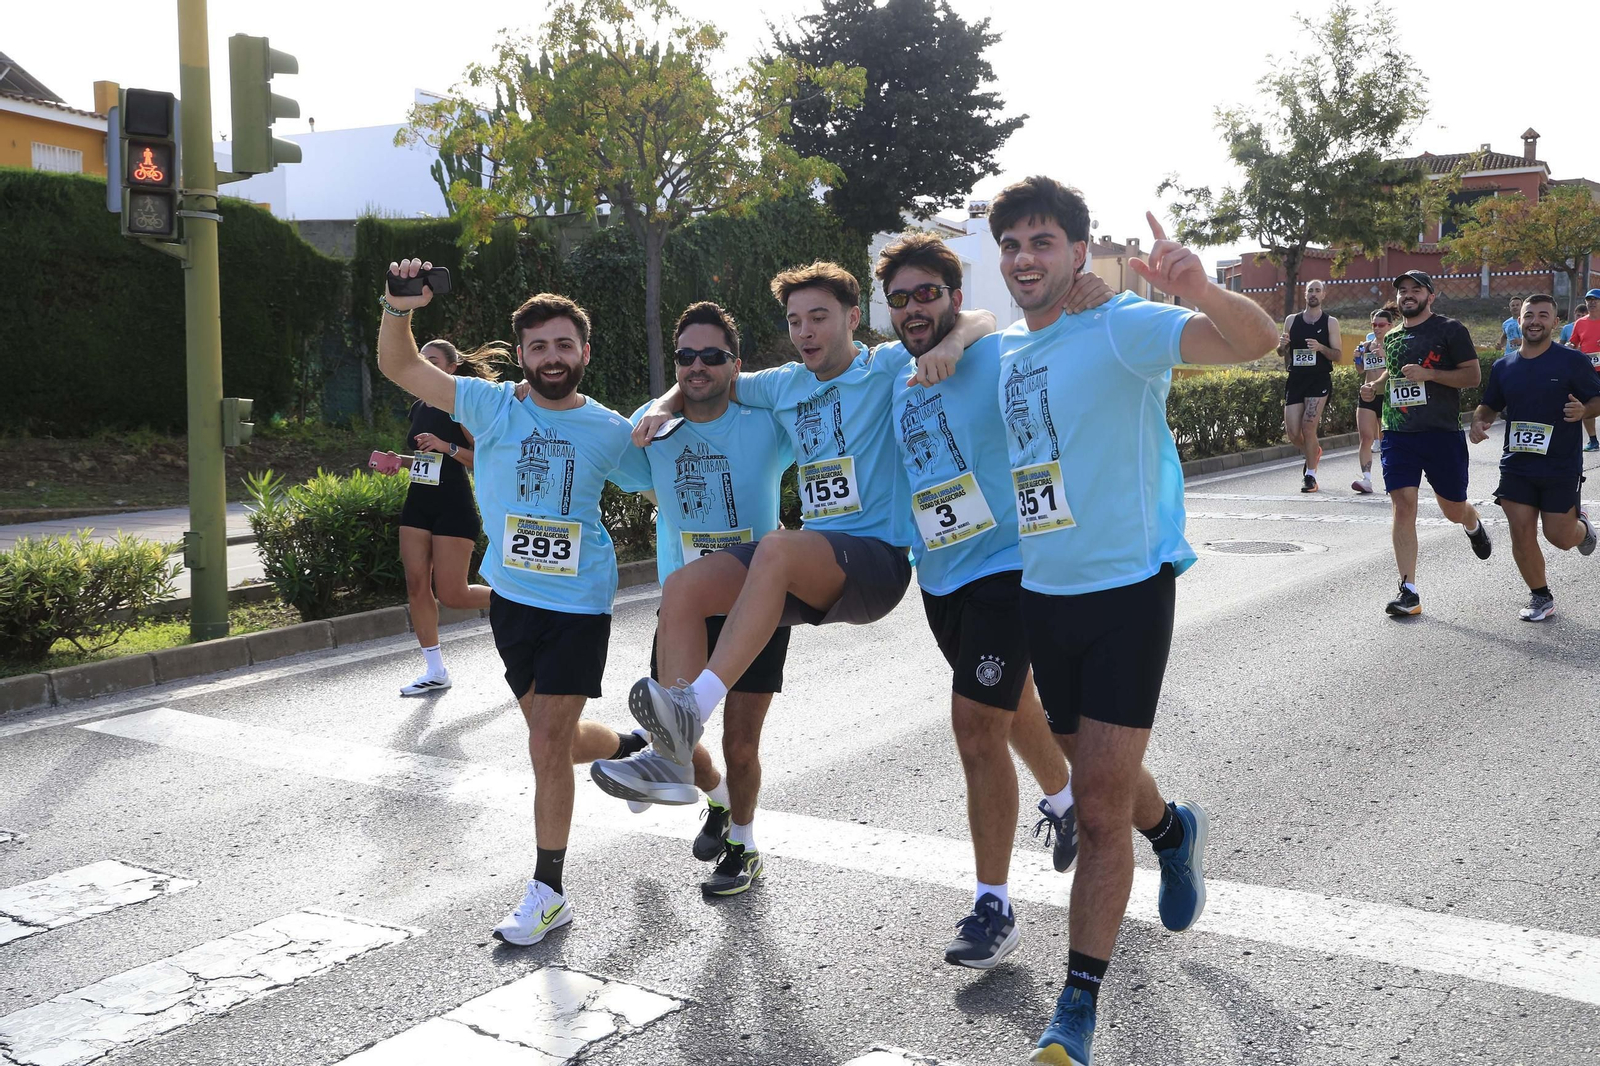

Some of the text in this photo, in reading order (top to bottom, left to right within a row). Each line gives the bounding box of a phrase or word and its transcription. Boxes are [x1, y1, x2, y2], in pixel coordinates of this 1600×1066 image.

[1022, 355, 1033, 372] XXV
[1026, 366, 1048, 378] CARRERA
[1024, 372, 1047, 394] URBANA
[1394, 386, 1420, 398] 106
[920, 399, 943, 421] URBANA
[544, 428, 557, 439] XXV
[1514, 432, 1545, 445] 132
[696, 442, 709, 455] XXV
[939, 414, 964, 469] ALGECIRAS
[547, 444, 575, 458] URBANA
[414, 462, 429, 474] 41
[701, 460, 730, 473] URBANA
[821, 464, 842, 473] URBANA
[821, 470, 843, 479] ALGECIRAS
[1029, 470, 1051, 481] URBANA
[562, 461, 573, 514] ALGECIRAS
[1030, 478, 1052, 488] ALGECIRAS
[804, 477, 849, 504] 153
[918, 484, 963, 504] CARRERA URBANA
[723, 474, 736, 526] ALGECIRAS
[920, 502, 934, 510] CIUDAD
[940, 490, 966, 504] ALGECIRAS
[1018, 485, 1057, 516] 351
[935, 504, 957, 528] 3
[518, 523, 544, 531] CARRERA
[512, 534, 571, 560] 293
